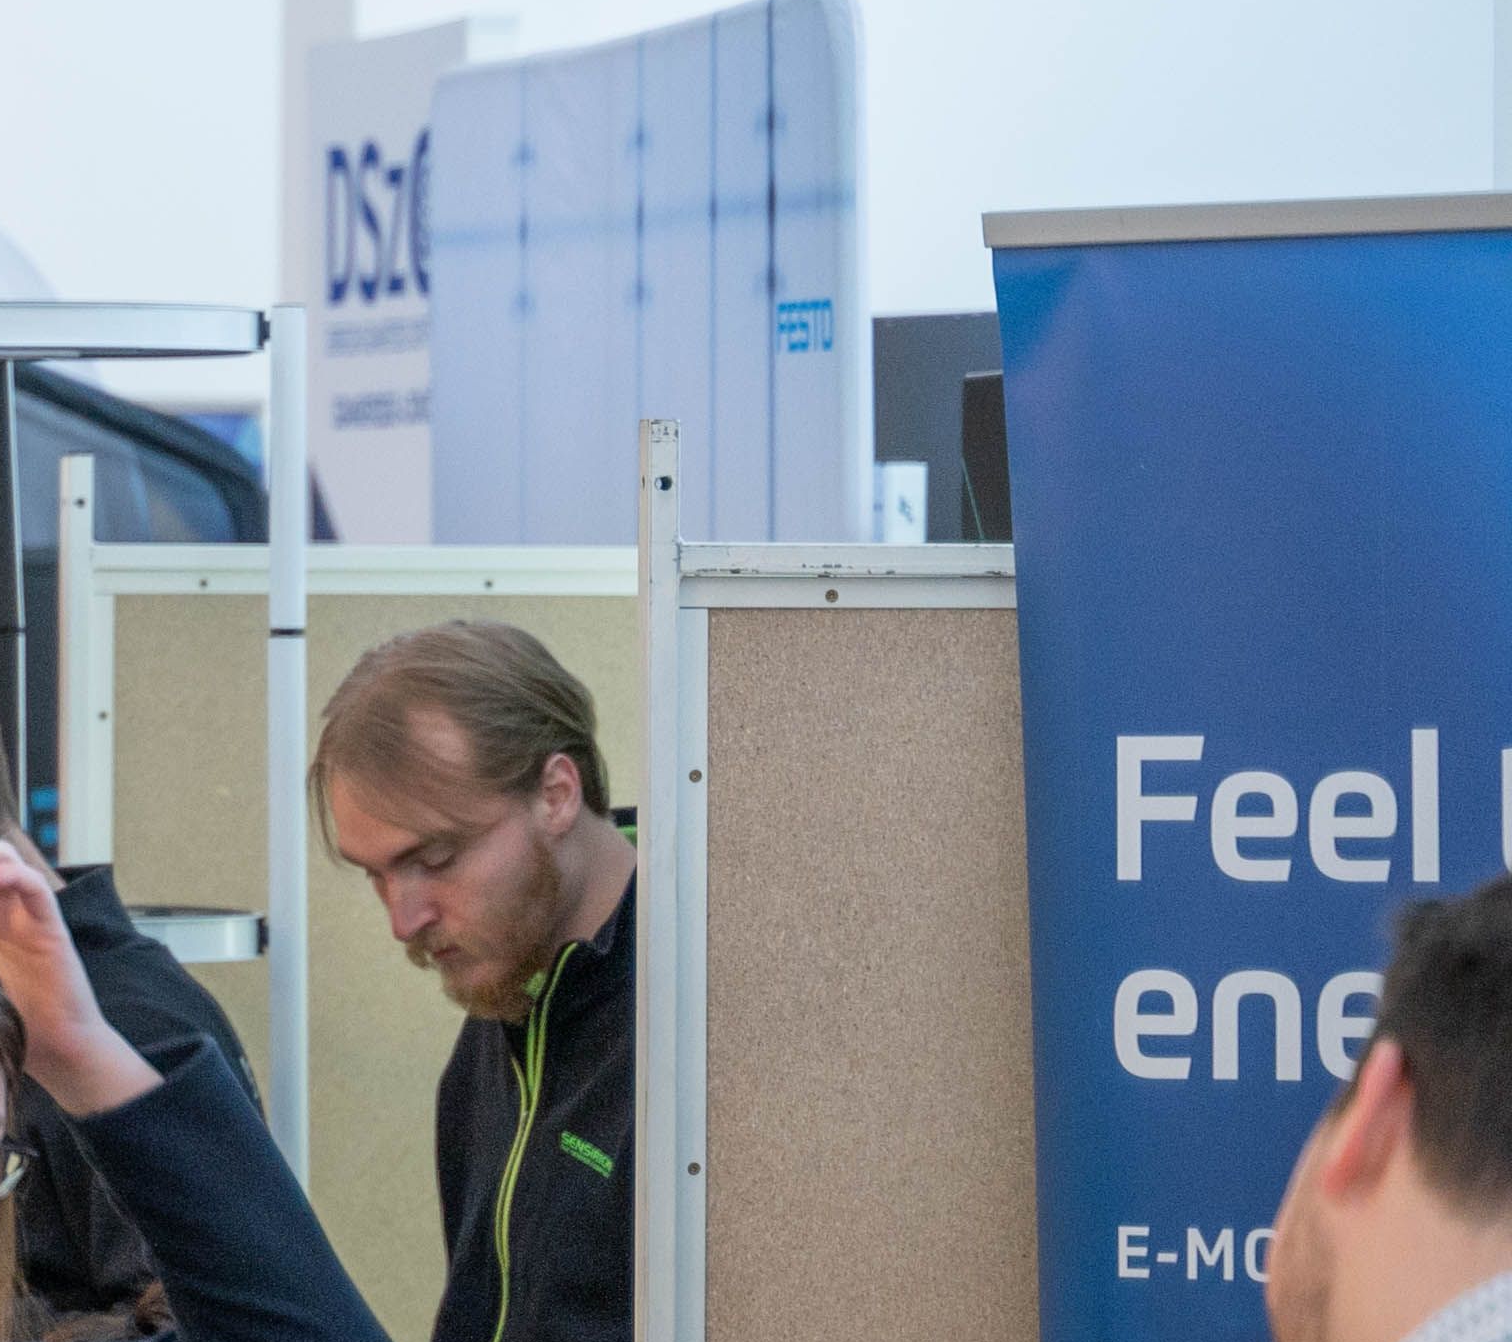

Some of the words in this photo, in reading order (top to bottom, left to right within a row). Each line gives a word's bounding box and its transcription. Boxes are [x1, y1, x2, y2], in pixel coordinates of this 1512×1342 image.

[775, 299, 834, 353] FESTO
[1116, 728, 1440, 883] Feel
[1113, 969, 1386, 1082] ene
[1116, 1225, 1277, 1283] E-MO
